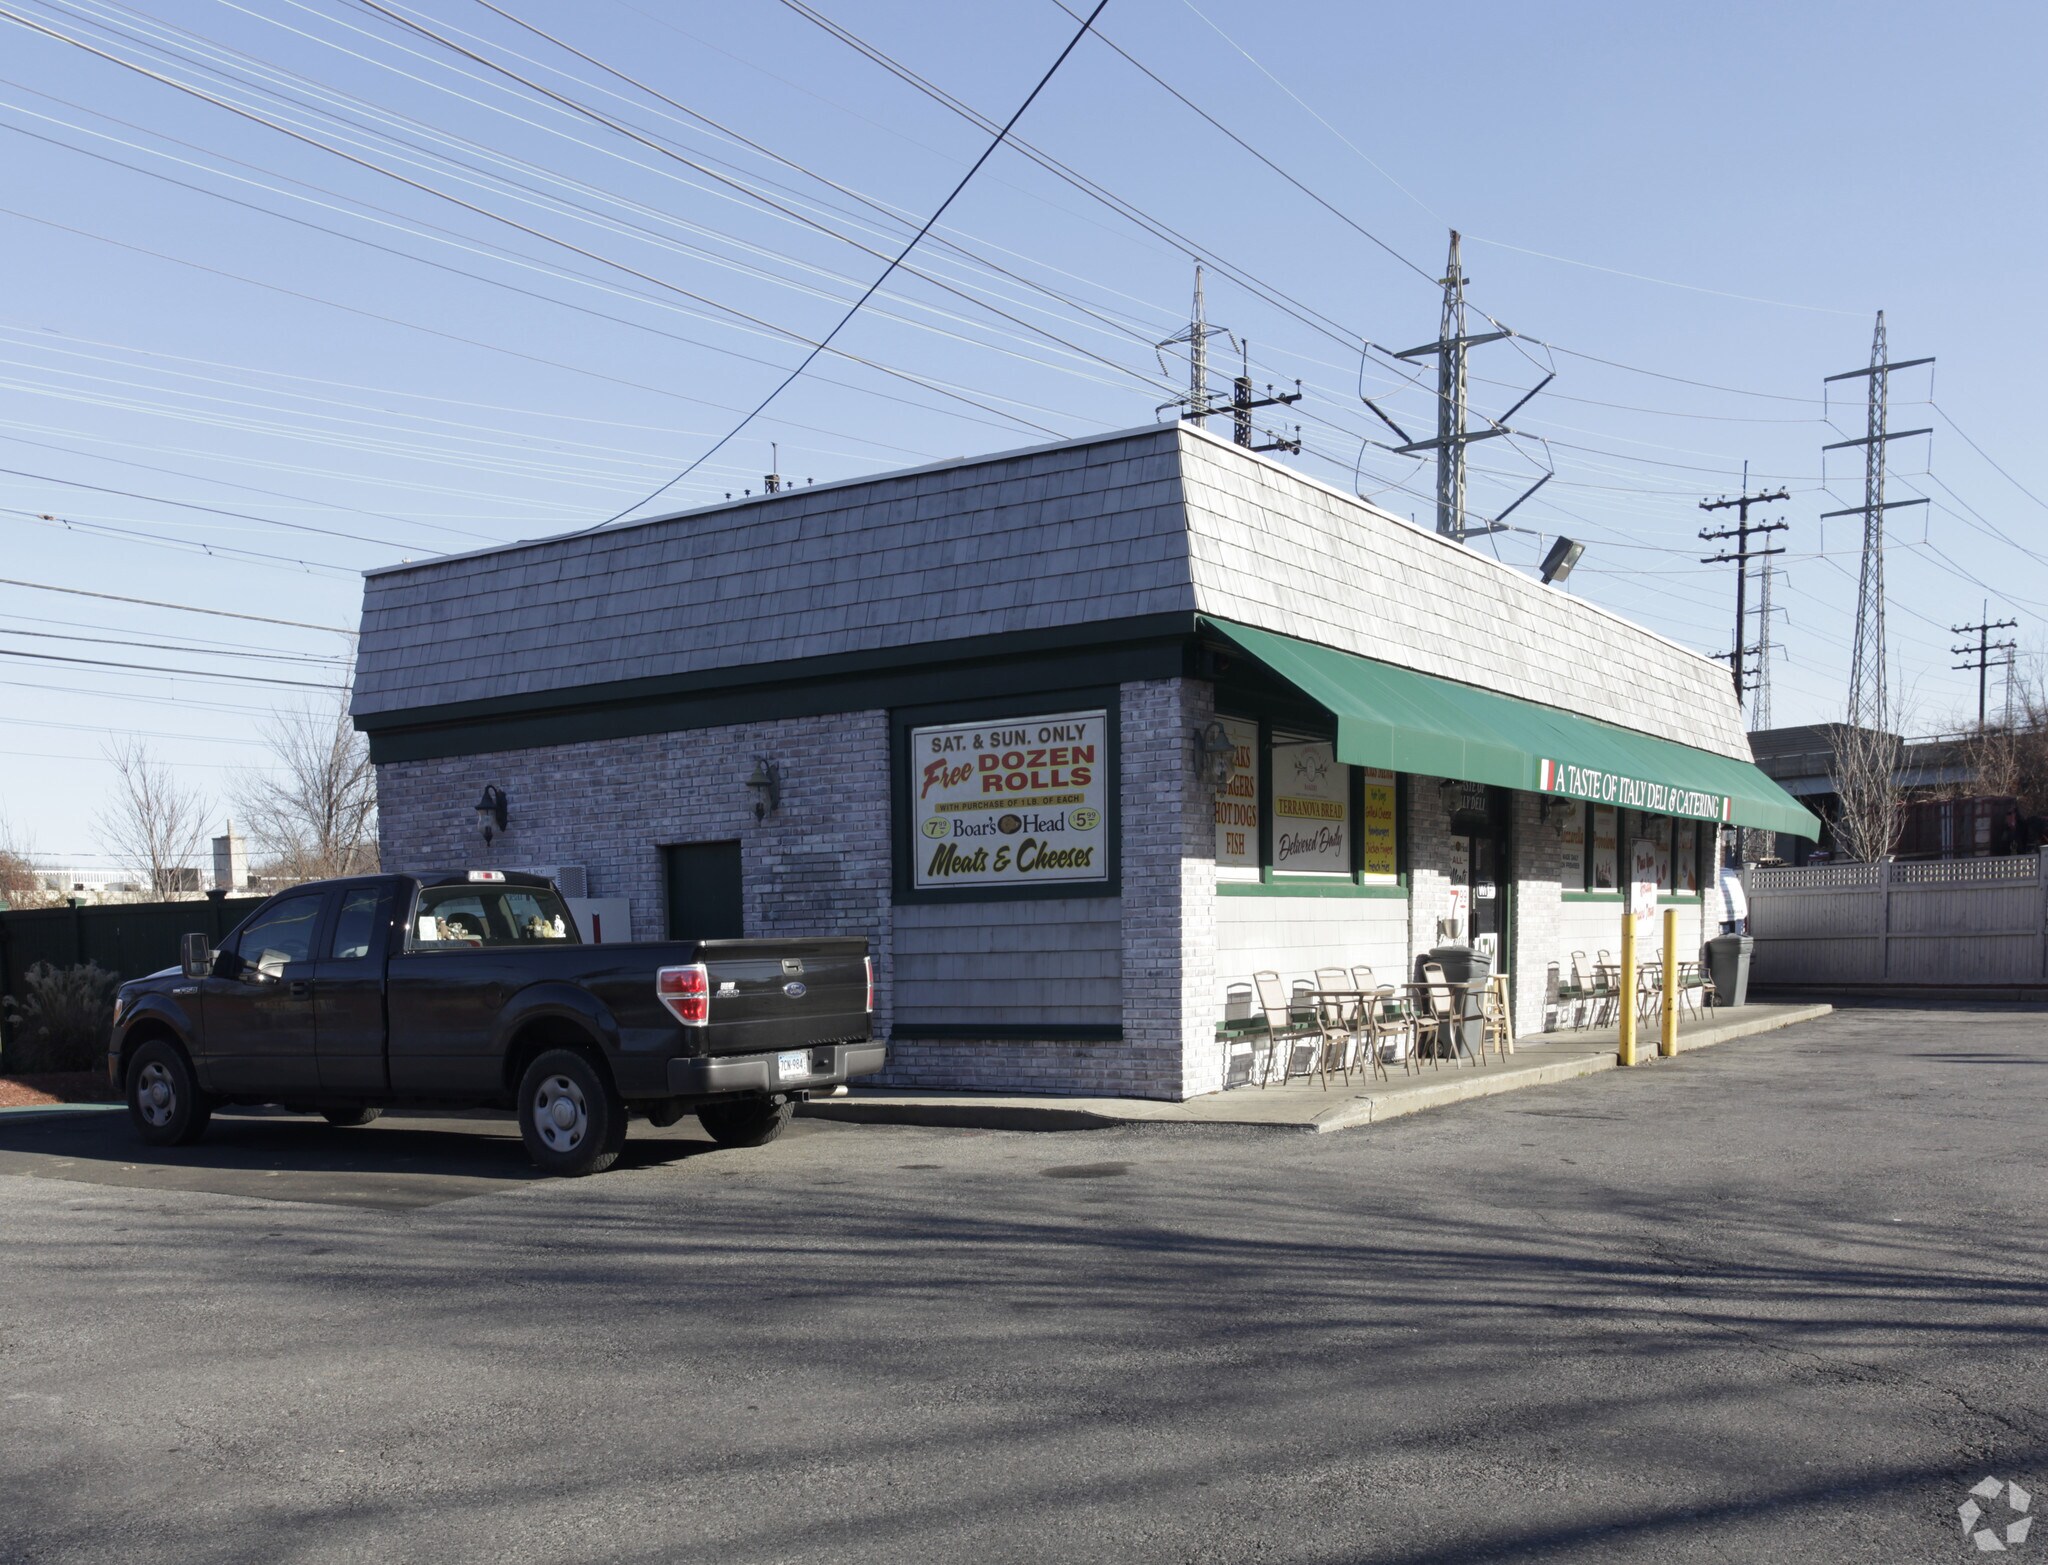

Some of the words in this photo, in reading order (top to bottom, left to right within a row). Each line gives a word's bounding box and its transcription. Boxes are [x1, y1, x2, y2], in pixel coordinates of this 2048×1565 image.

[931, 736, 966, 753] SAT.
[973, 734, 983, 749] &
[990, 729, 1031, 748] SUN.
[1038, 724, 1086, 743] ONLY
[921, 758, 974, 799] Free
[978, 745, 1095, 772] DOZEN
[982, 767, 1092, 793] ROLLS
[939, 804, 959, 812] WITH
[962, 801, 1004, 811] PURCHASE
[1007, 799, 1017, 808] OF
[1042, 796, 1052, 805] OF
[1056, 794, 1080, 804] EACH
[1555, 764, 1566, 792] A
[1568, 766, 1601, 799] TASTE
[1602, 773, 1617, 801] OF
[1619, 777, 1647, 806] ITALY
[1647, 783, 1668, 810] DELI
[1669, 788, 1677, 812] &
[1676, 789, 1719, 819] CATERING
[1215, 801, 1233, 825] HOT
[1234, 803, 1257, 827] DOGS
[1278, 798, 1320, 817] TERRANOVA
[1321, 802, 1343, 818] BREAD
[953, 816, 997, 838] Boar's
[1023, 812, 1065, 833] Head
[1226, 832, 1245, 855] FISH
[1279, 831, 1319, 861] Delivered
[1319, 825, 1343, 857] Daily
[927, 843, 989, 877] Meats
[993, 845, 1011, 872] &
[1016, 838, 1094, 873] Cheeses
